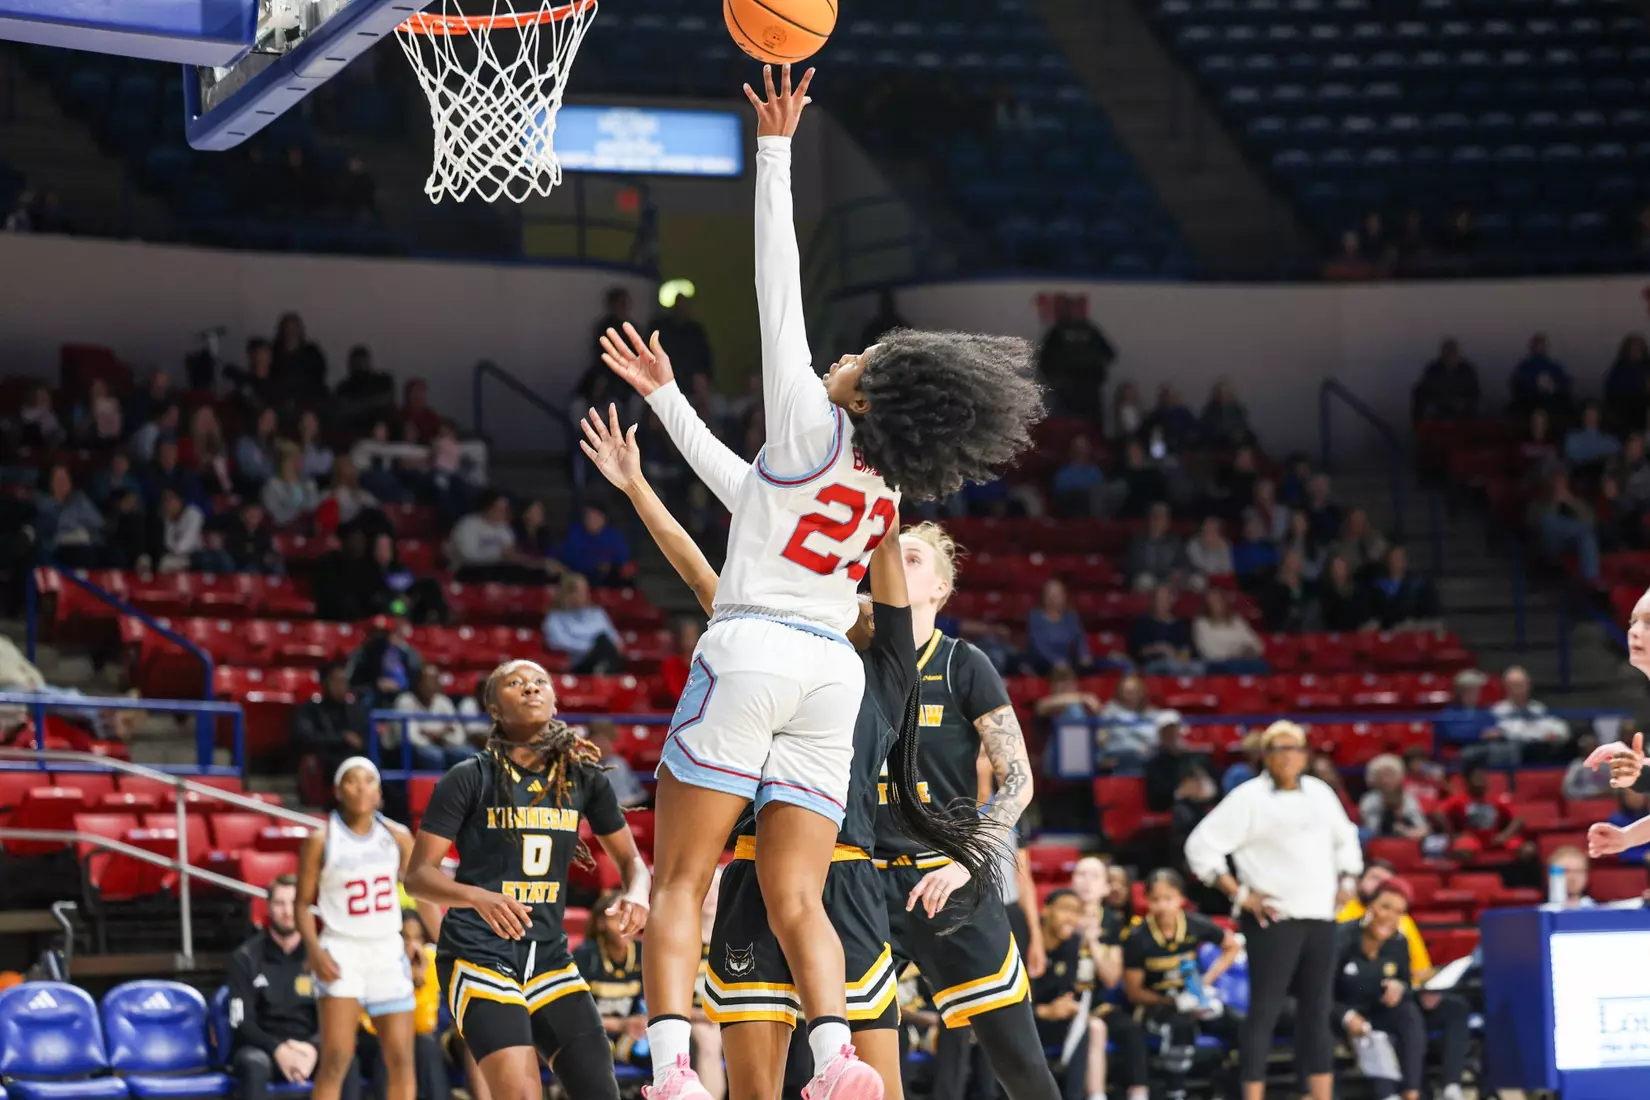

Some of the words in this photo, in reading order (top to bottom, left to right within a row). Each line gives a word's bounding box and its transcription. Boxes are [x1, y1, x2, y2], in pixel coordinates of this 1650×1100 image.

[521, 833, 553, 877] 0
[344, 876, 392, 916] 22
[502, 880, 560, 904] STATE
